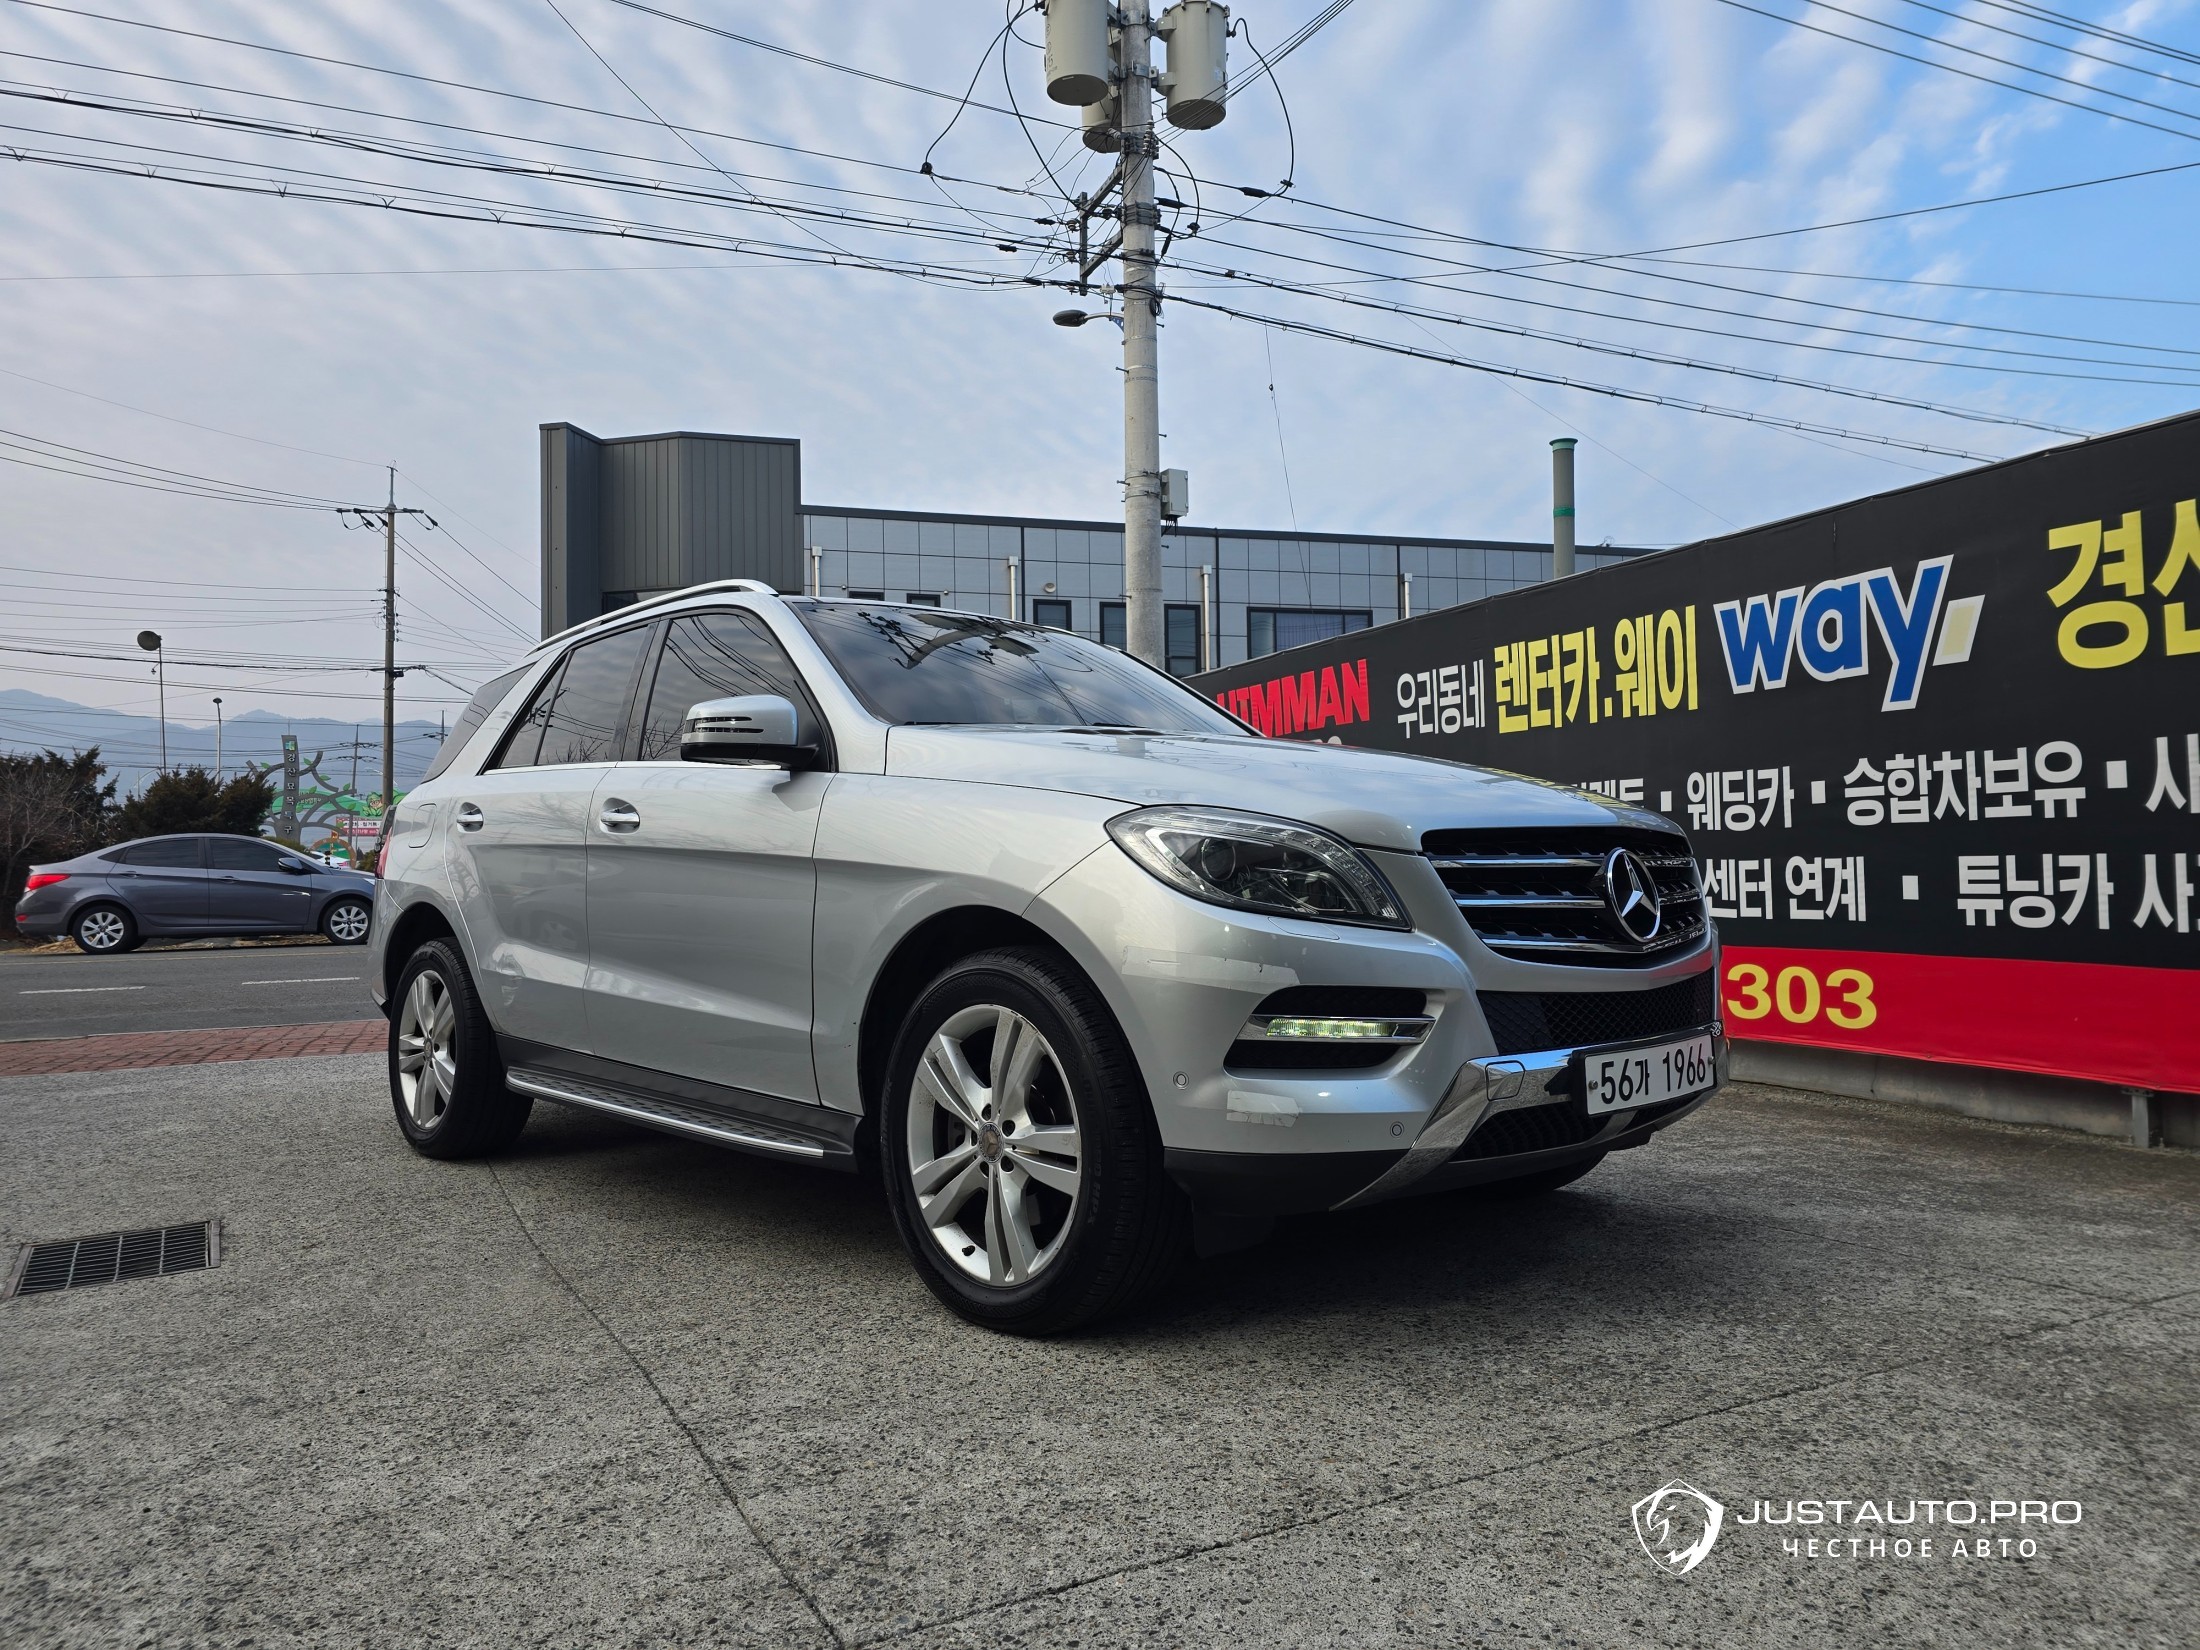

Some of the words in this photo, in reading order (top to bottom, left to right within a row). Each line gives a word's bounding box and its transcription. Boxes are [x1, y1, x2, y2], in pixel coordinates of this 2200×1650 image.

[1397, 659, 1486, 739] 우리동네
[1687, 766, 1795, 831] 웨딩카
[1843, 741, 2086, 826] 승합차보유
[1702, 858, 1774, 919] 센터
[1785, 856, 1866, 921] 연계
[1957, 853, 2114, 929] 튜닝카
[2133, 853, 2200, 933] 사
[1600, 1058, 1650, 1105] 56가
[1662, 1043, 1706, 1093] 1966
